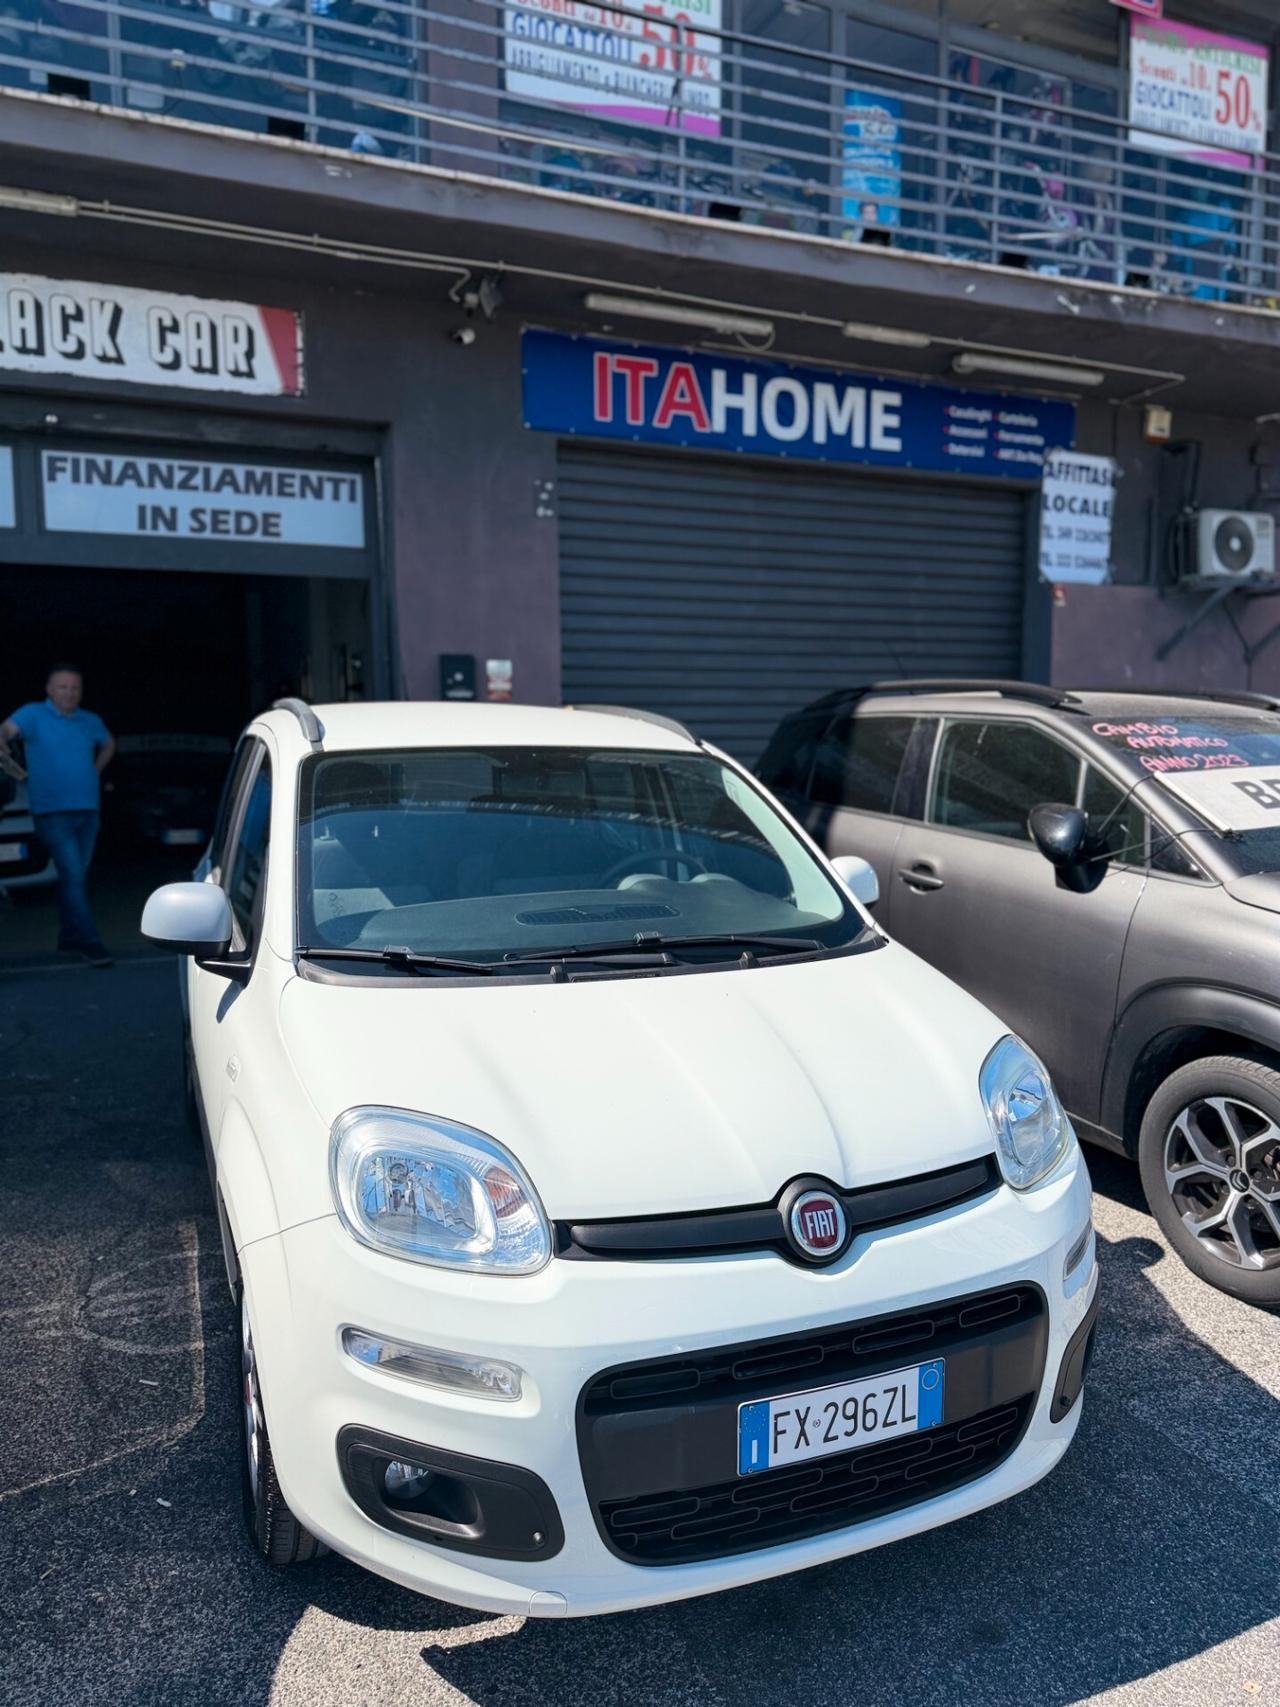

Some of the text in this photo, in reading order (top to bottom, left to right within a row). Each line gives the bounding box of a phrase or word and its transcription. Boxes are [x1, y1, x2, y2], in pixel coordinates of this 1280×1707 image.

[512, 12, 633, 64] GIOCATTOLI
[0, 288, 256, 379] ACK CAR
[593, 351, 903, 452] ITAHOME
[46, 455, 357, 504] FINANZIAMENTI
[137, 504, 282, 538] IN SEDE
[1041, 494, 1110, 518] LOCALE
[1092, 722, 1179, 736] CAMBIO
[1126, 736, 1228, 749] AUTOMATICO
[1139, 753, 1249, 772] ANNO 2023
[804, 1208, 834, 1240] FIAT
